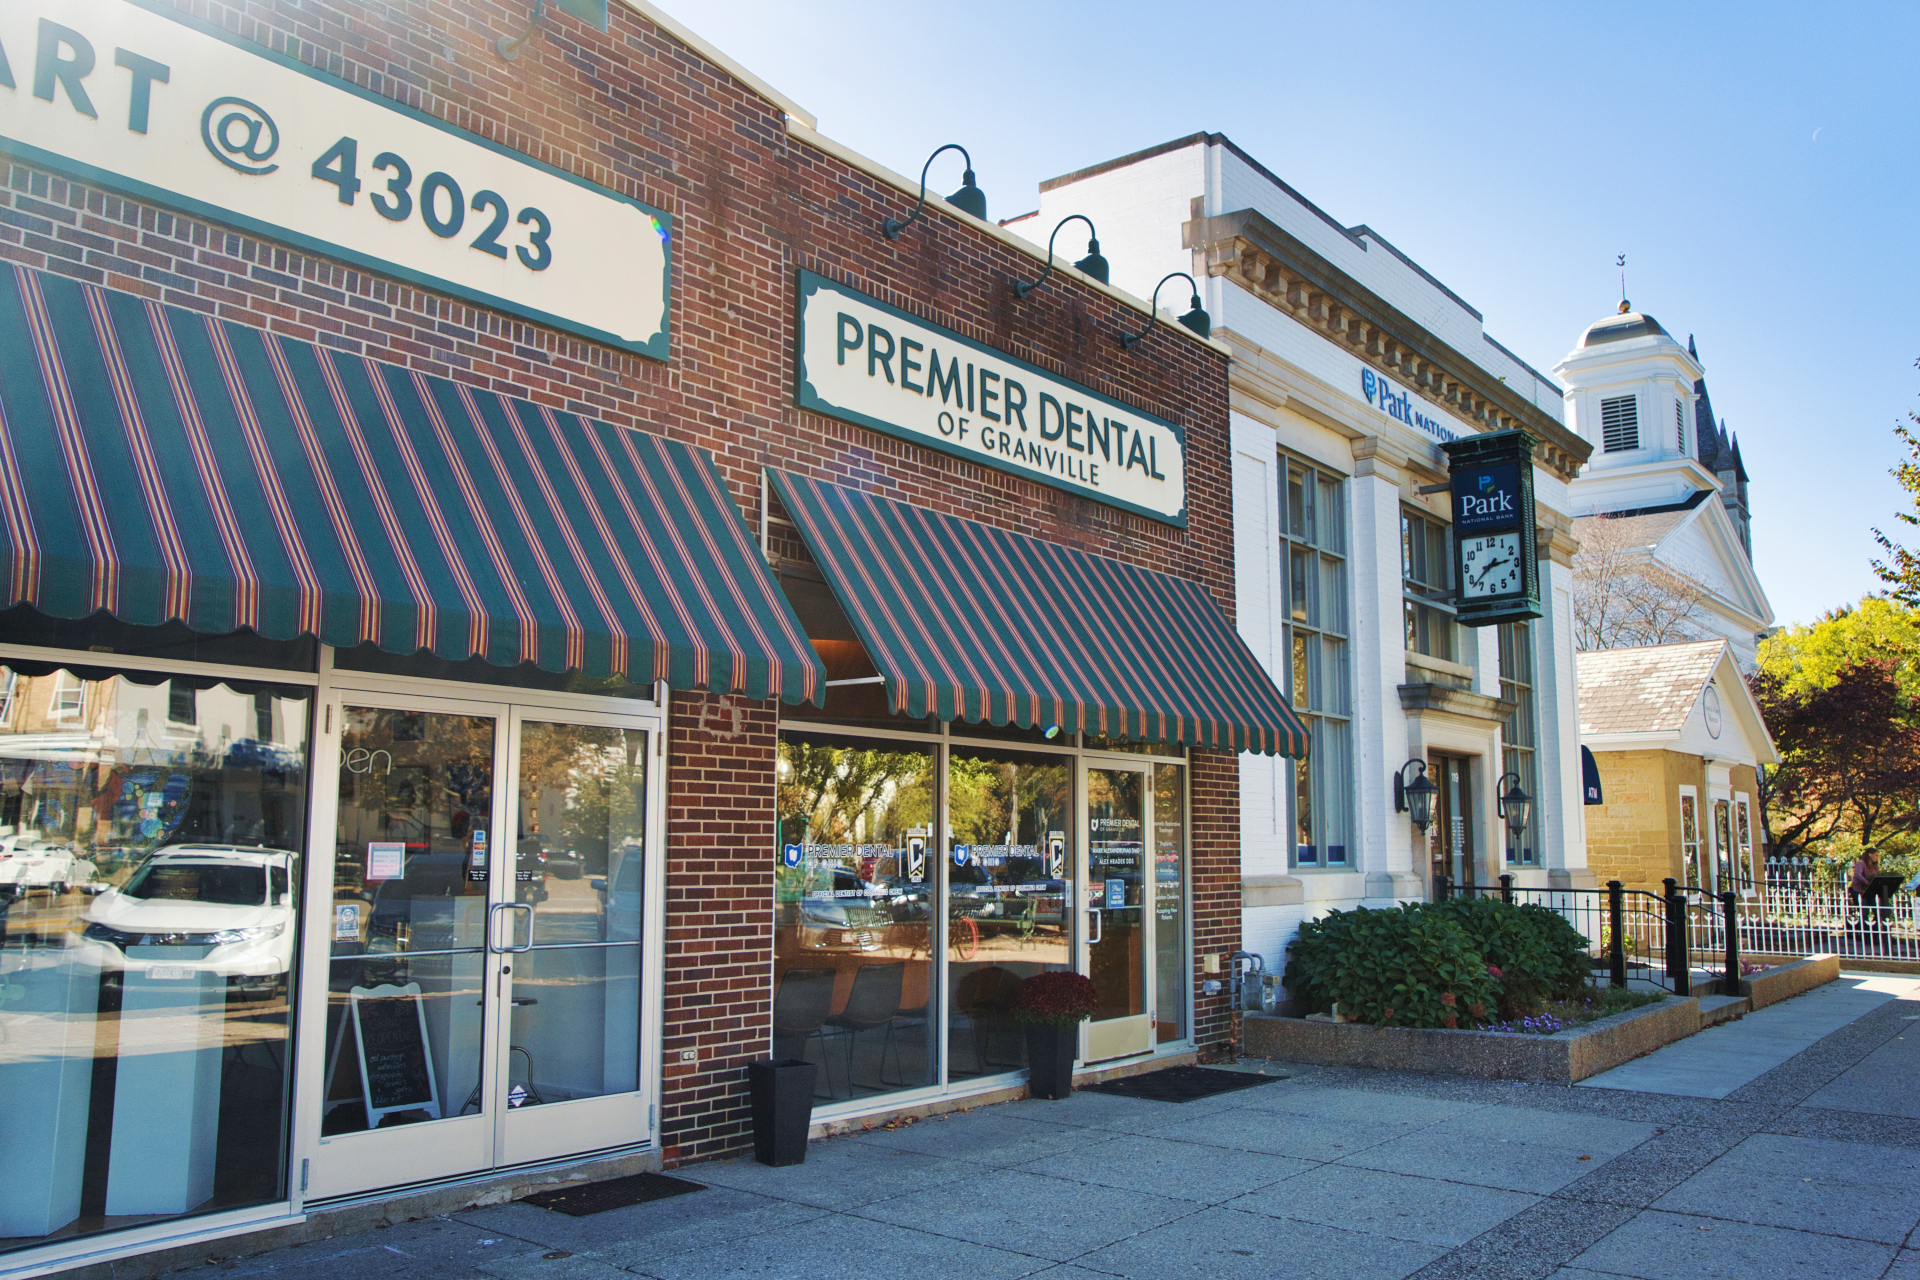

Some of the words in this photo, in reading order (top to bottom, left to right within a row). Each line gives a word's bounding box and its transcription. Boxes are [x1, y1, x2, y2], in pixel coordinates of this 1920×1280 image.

[0, 17, 170, 135] RT
[311, 136, 552, 271] 43023
[837, 311, 1027, 431] PREMIER
[1040, 391, 1165, 481] DENTAL
[1378, 377, 1414, 427] Park
[938, 411, 970, 440] OF
[981, 426, 1100, 486] GRANVILLE
[1461, 490, 1513, 517] Park
[1476, 541, 1482, 552] 11
[1486, 537, 1495, 548] 12
[1500, 538, 1504, 548] 1
[1467, 550, 1475, 561] 10
[1508, 545, 1514, 556] 2
[1514, 557, 1520, 568] 3
[1464, 564, 1469, 574] 9
[1469, 574, 1474, 584] 8
[1509, 570, 1516, 580] 4
[1479, 581, 1484, 591] 7
[1490, 584, 1496, 593] 6
[1501, 578, 1507, 589] 5
[808, 844, 854, 858] PREMIER
[856, 844, 894, 858] DENTAL
[972, 845, 1009, 857] PREMIER
[1010, 845, 1039, 857] DENTAL
[808, 859, 817, 868] OF
[822, 859, 843, 868] OHIO
[971, 858, 980, 866] OF
